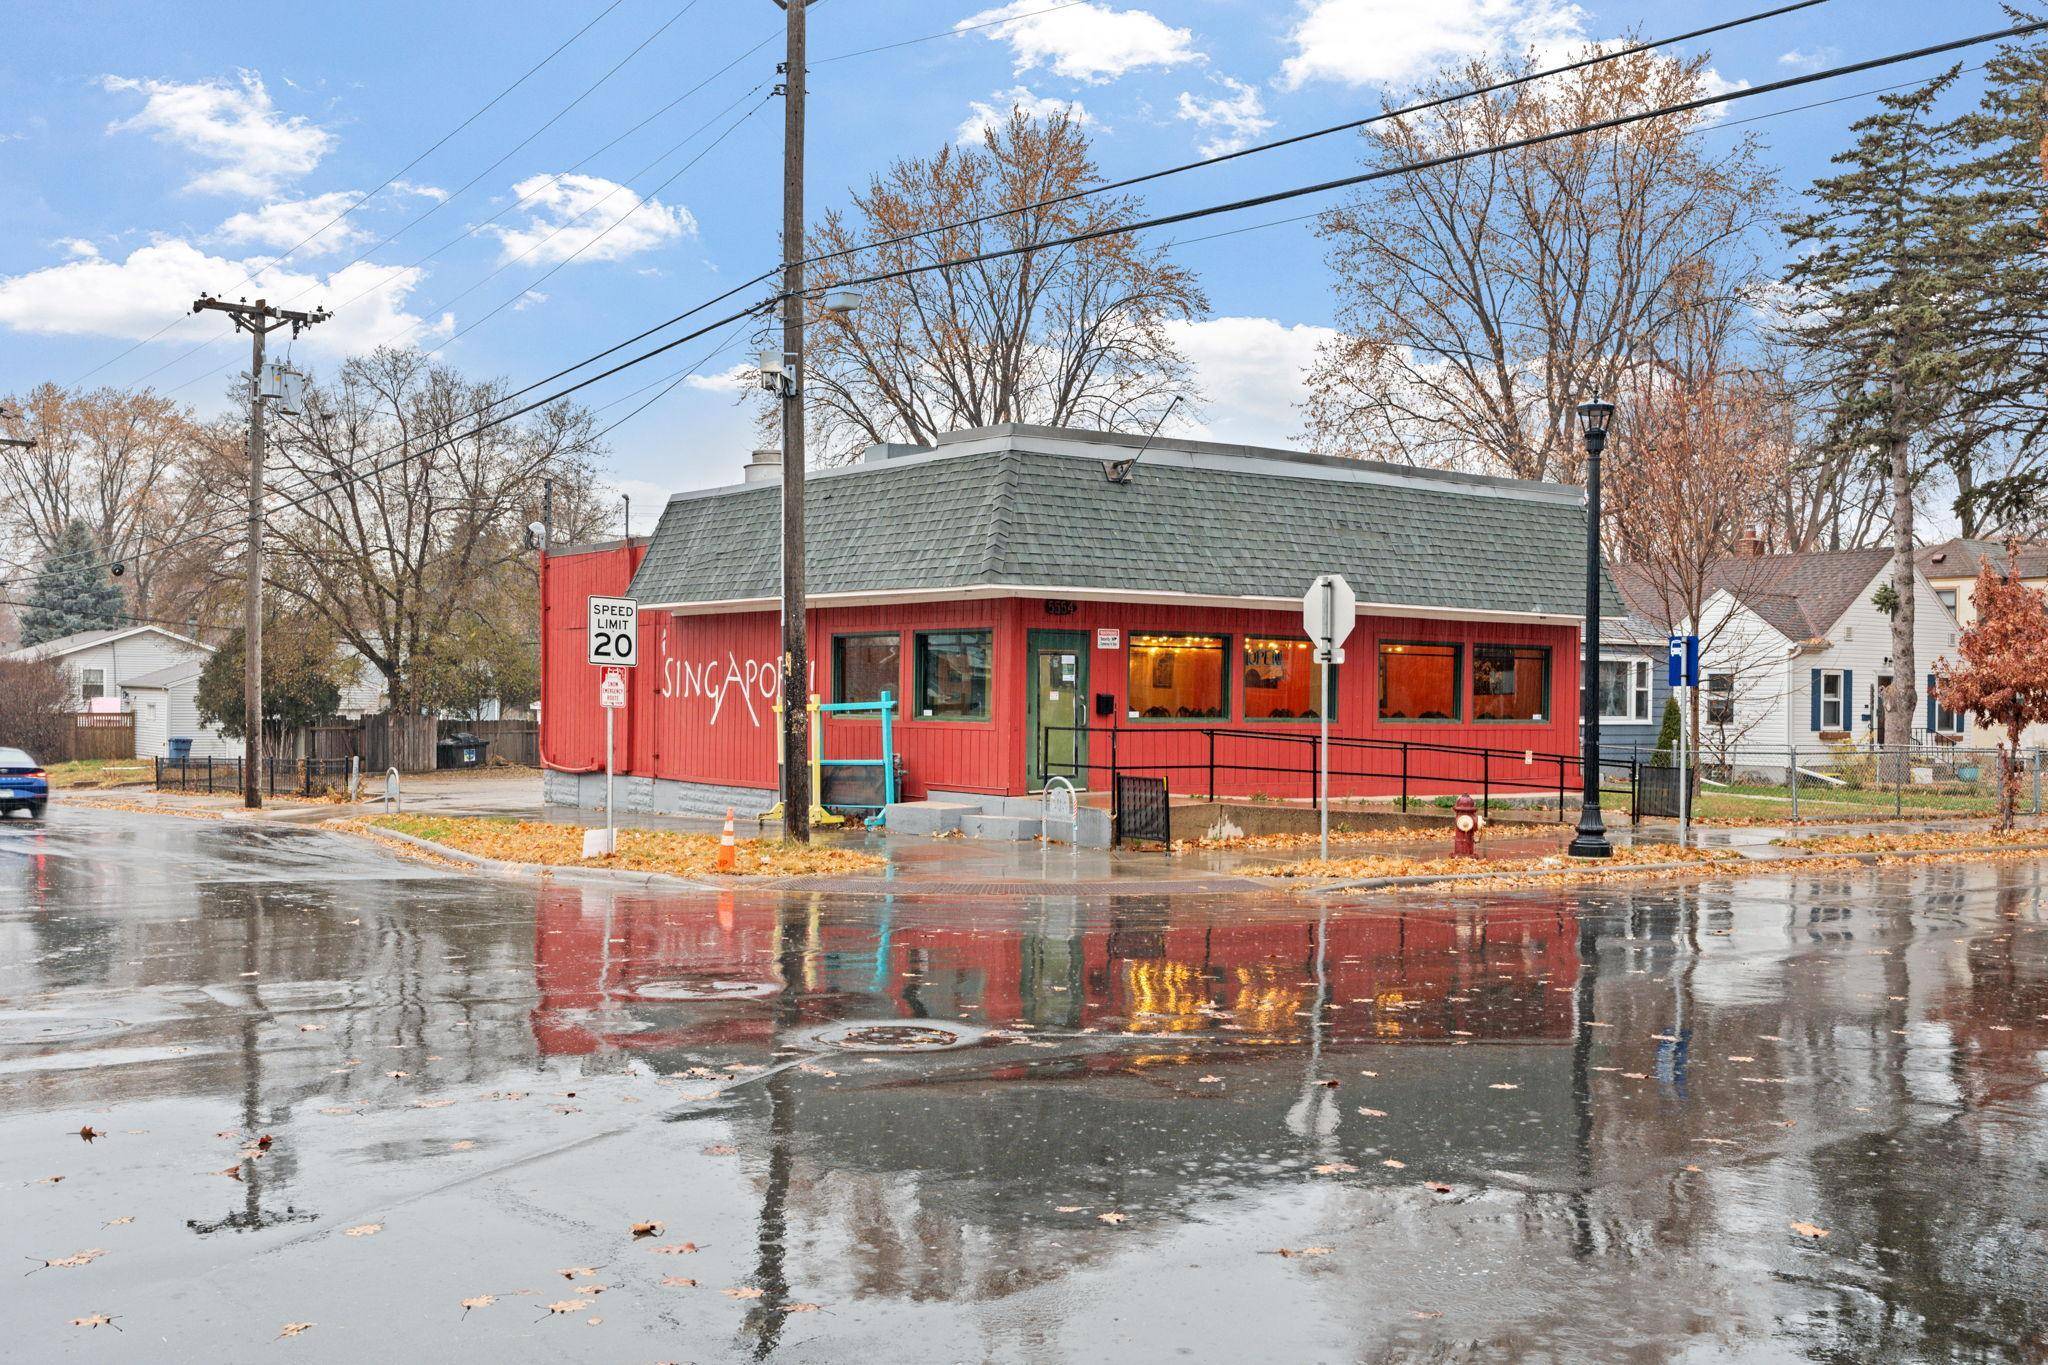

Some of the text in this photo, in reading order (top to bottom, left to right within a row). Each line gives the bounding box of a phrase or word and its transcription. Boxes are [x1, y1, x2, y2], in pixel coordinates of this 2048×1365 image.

[593, 604, 634, 617] SPEED
[597, 618, 629, 630] LIMIT
[594, 632, 633, 657] 20
